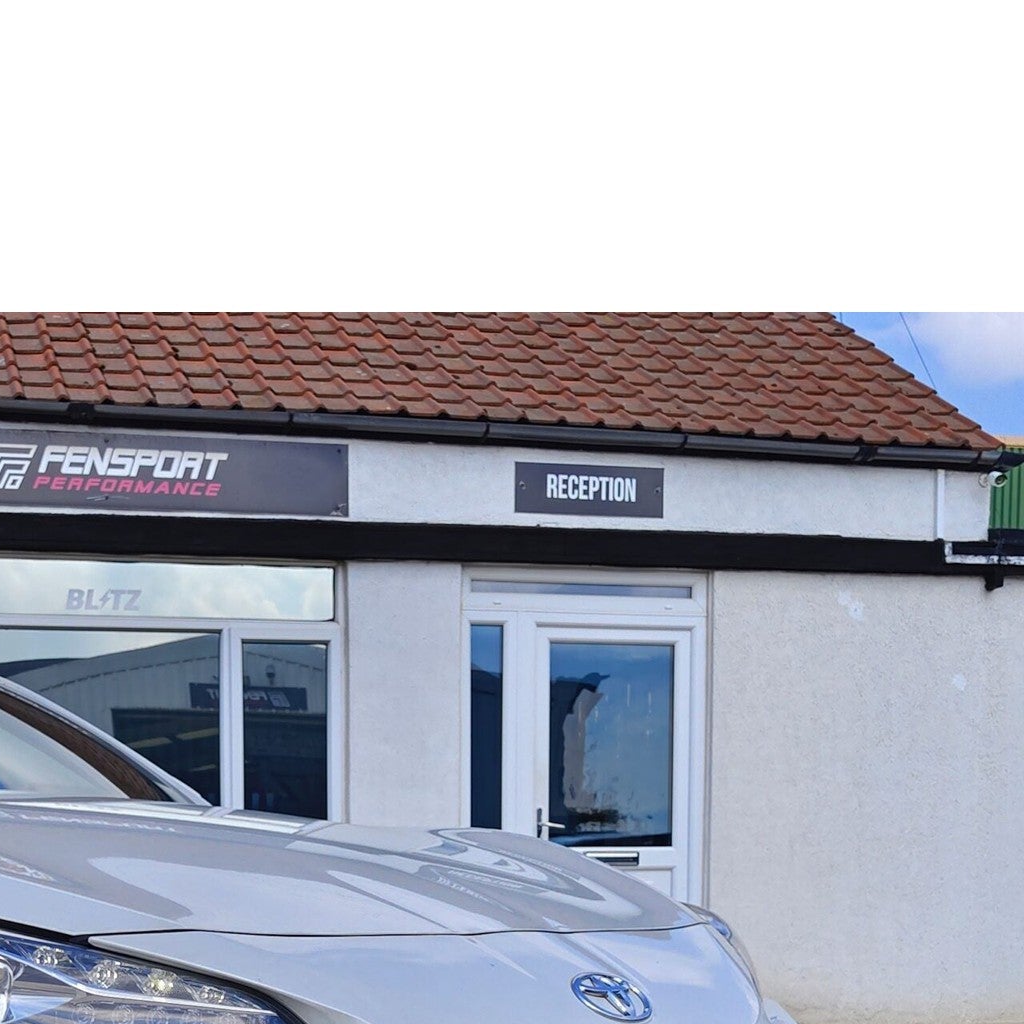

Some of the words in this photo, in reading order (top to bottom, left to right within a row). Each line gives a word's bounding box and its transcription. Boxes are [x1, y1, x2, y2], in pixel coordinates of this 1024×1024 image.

[38, 445, 229, 481] FENSPORT
[32, 476, 222, 497] PERFORMANCE
[546, 474, 637, 503] RECEPTION
